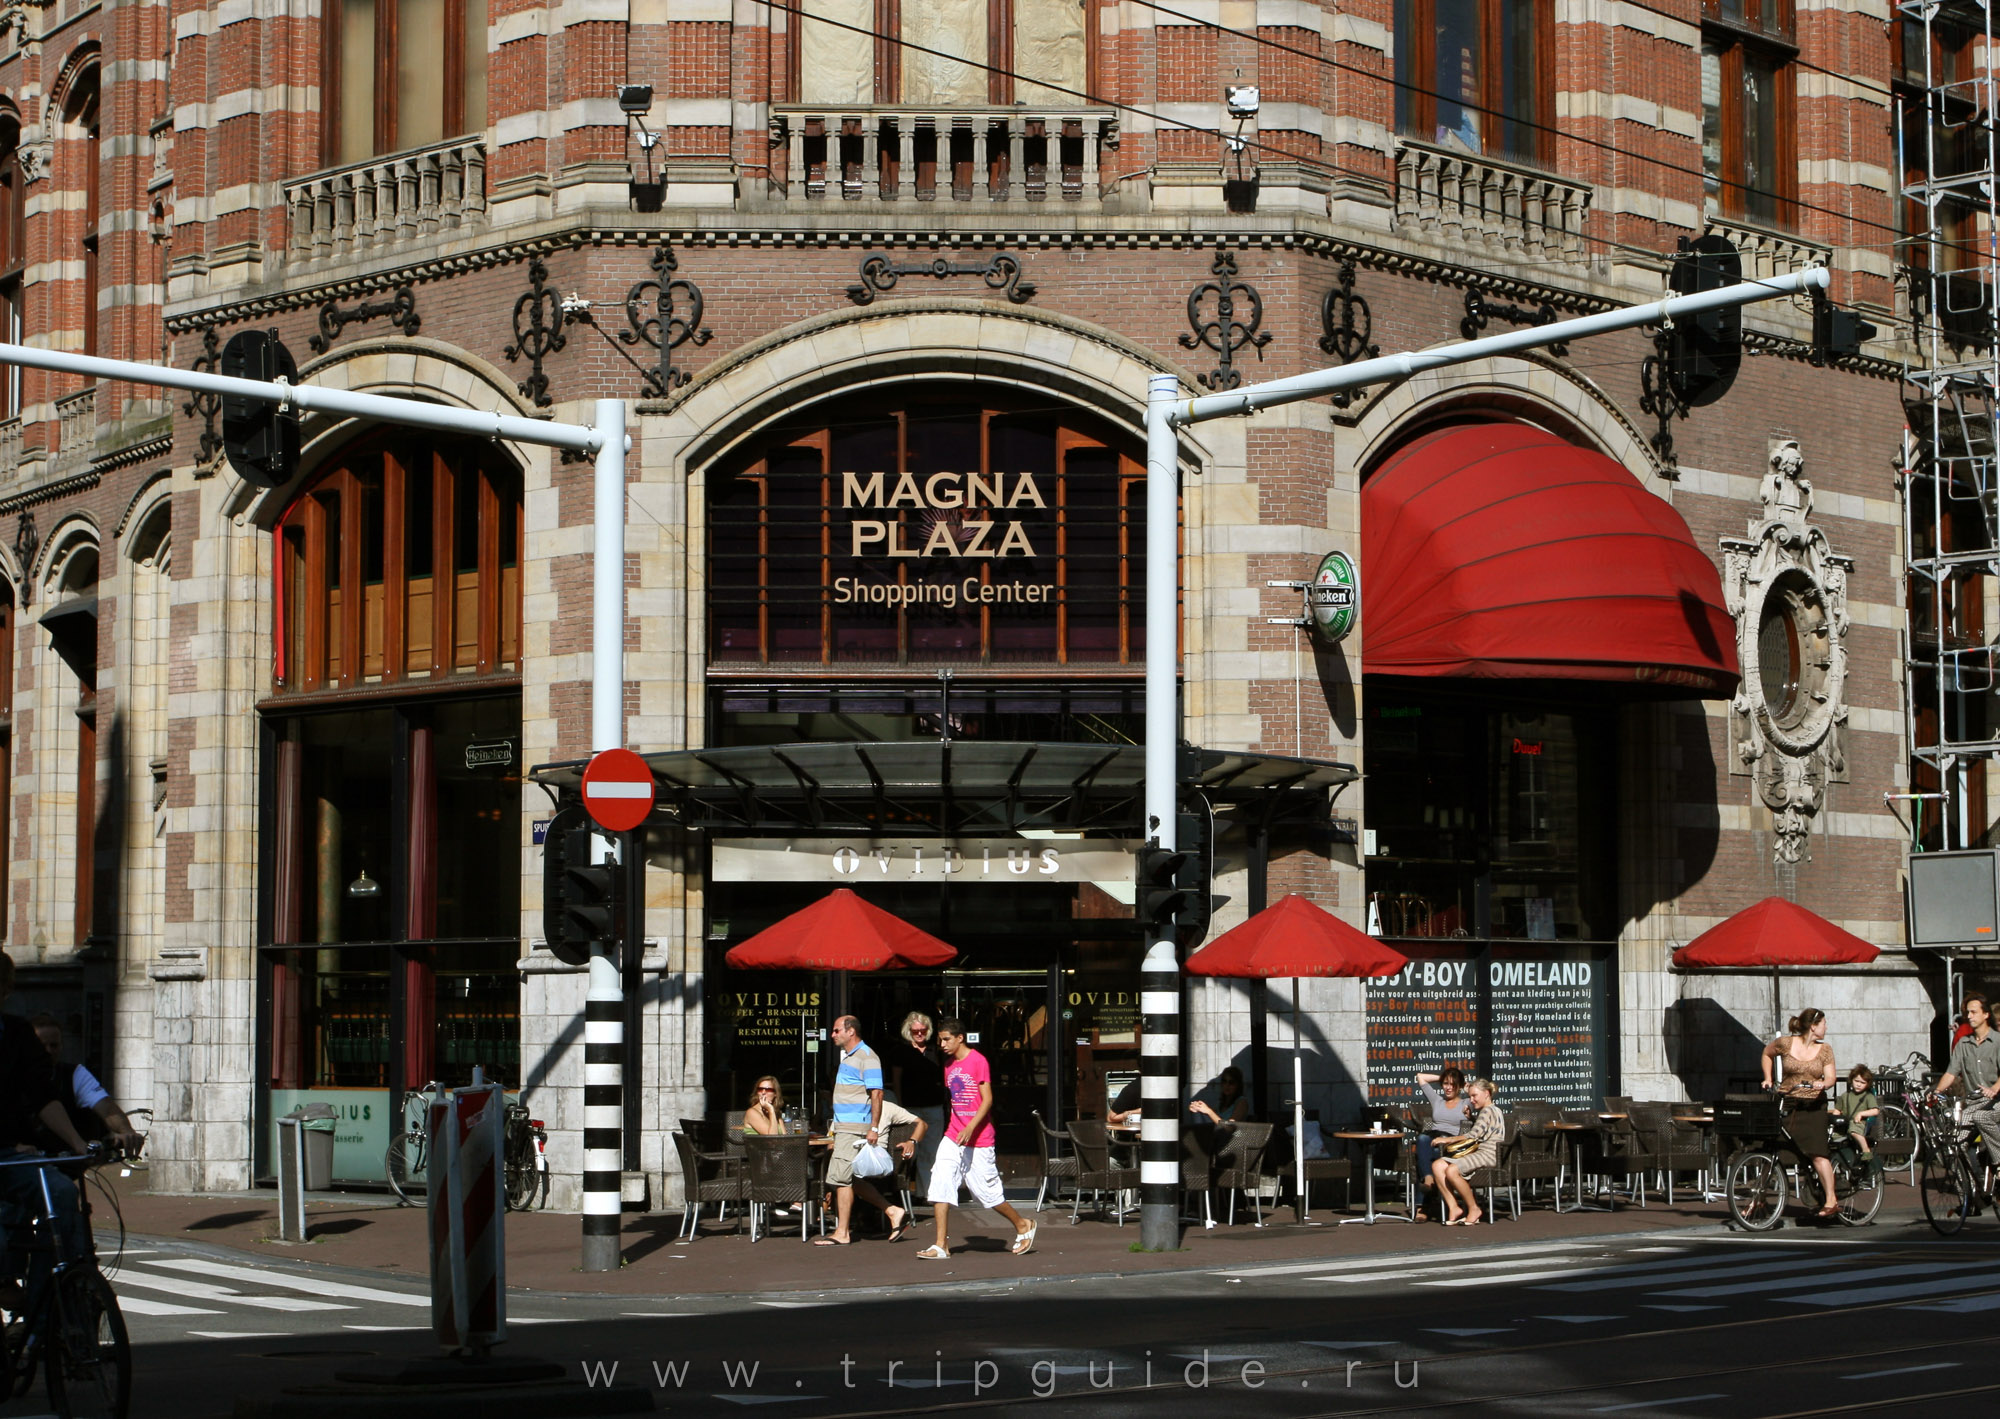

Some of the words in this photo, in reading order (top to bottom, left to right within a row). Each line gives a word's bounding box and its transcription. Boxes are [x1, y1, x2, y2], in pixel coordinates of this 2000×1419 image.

[842, 472, 1047, 509] MAGNA
[851, 519, 1037, 558] PLAZA
[834, 577, 956, 608] Shopping
[963, 577, 1054, 603] Center
[832, 846, 1060, 874] OVIDIUS
[719, 993, 820, 1006] OVIDIUS
[1423, 989, 1463, 1000] uitgebreid
[1512, 990, 1525, 998] aan
[1527, 989, 1555, 999] kleding
[1557, 989, 1571, 997] kan
[1413, 999, 1468, 1011] Homeland
[1535, 1002, 1563, 1011] prachtige
[1565, 1001, 1591, 1009] collectie
[1496, 1012, 1532, 1023] Sissy-Boy
[1534, 1012, 1571, 1021] Homeland
[1573, 1012, 1580, 1020] is
[1583, 1012, 1591, 1020] de
[738, 1028, 799, 1036] RESTAURANT
[1430, 1027, 1444, 1035] visie
[1459, 1027, 1476, 1035] Sissy
[1513, 1025, 1534, 1034] gebied
[1411, 1039, 1433, 1047] unieke
[1435, 1038, 1470, 1046] combinatie
[1512, 1037, 1534, 1045] nieuwe
[1556, 1033, 1592, 1043] kasten
[1444, 1050, 1476, 1059] prachtige
[1562, 1048, 1592, 1056] spiegels,
[1391, 1063, 1442, 1072] onverslijtbaar
[1554, 1060, 1592, 1068] kandelaars,
[1378, 1077, 1396, 1085] maar
[1544, 1071, 1558, 1079] hun
[1560, 1070, 1592, 1079] herkomst
[1519, 1083, 1573, 1092] woonaccessoires
[1575, 1082, 1592, 1090] heeft
